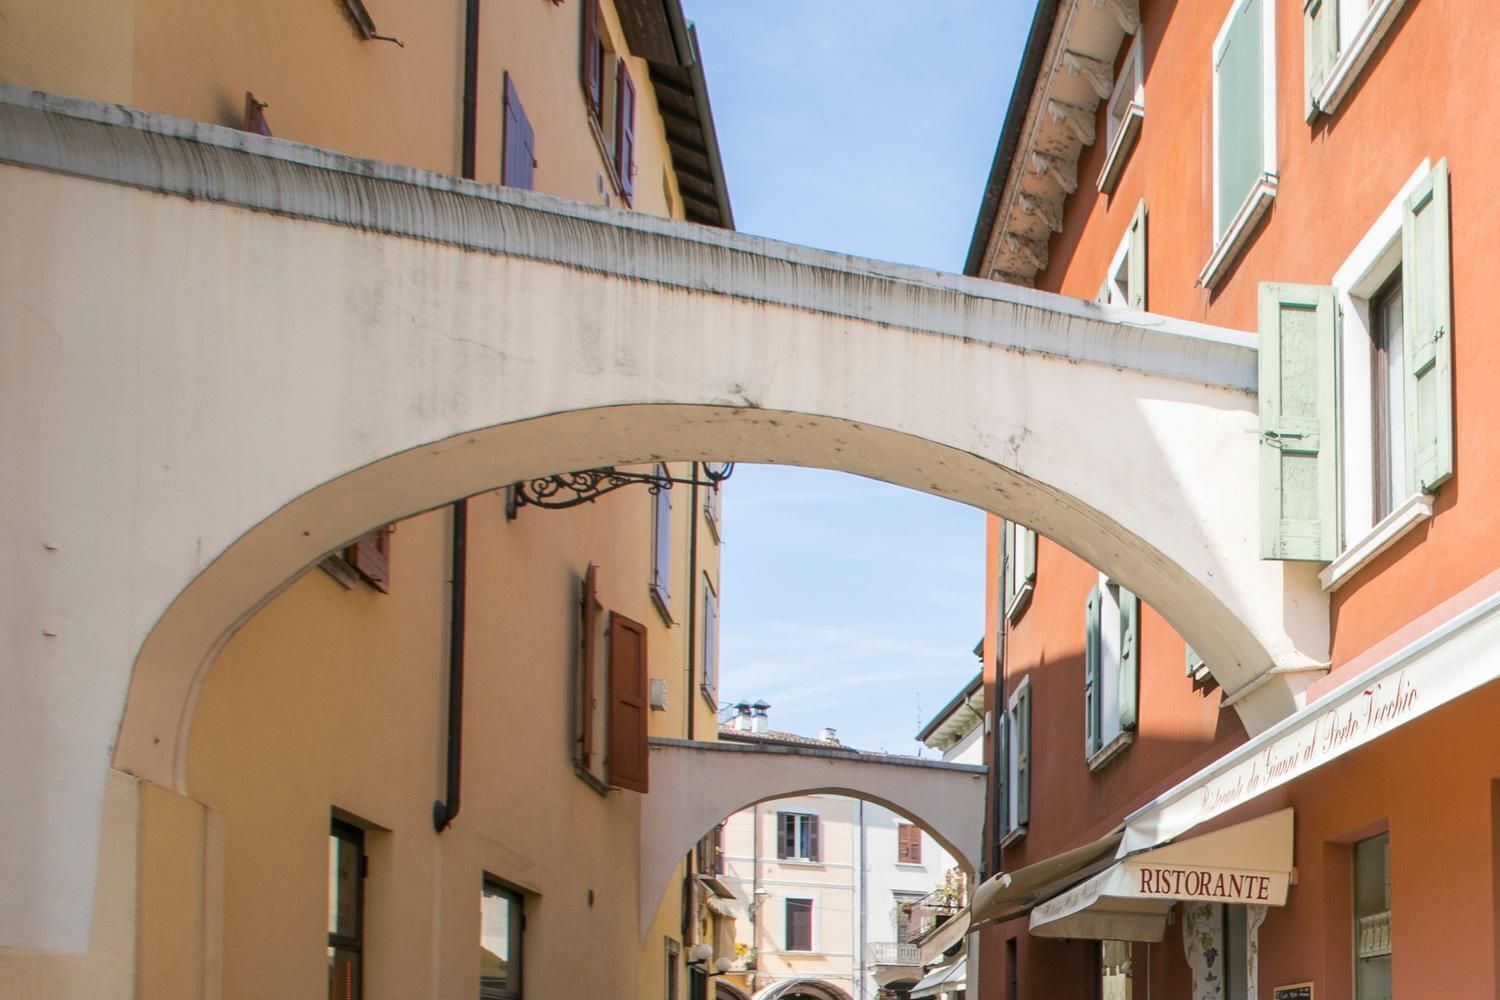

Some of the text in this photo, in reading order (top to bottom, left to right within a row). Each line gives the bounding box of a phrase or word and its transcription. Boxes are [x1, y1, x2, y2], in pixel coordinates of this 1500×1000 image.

[1303, 720, 1320, 761] al
[1320, 709, 1359, 754] Porto
[1361, 670, 1418, 735] Vecchio
[1139, 868, 1270, 900] RISTORANTE
